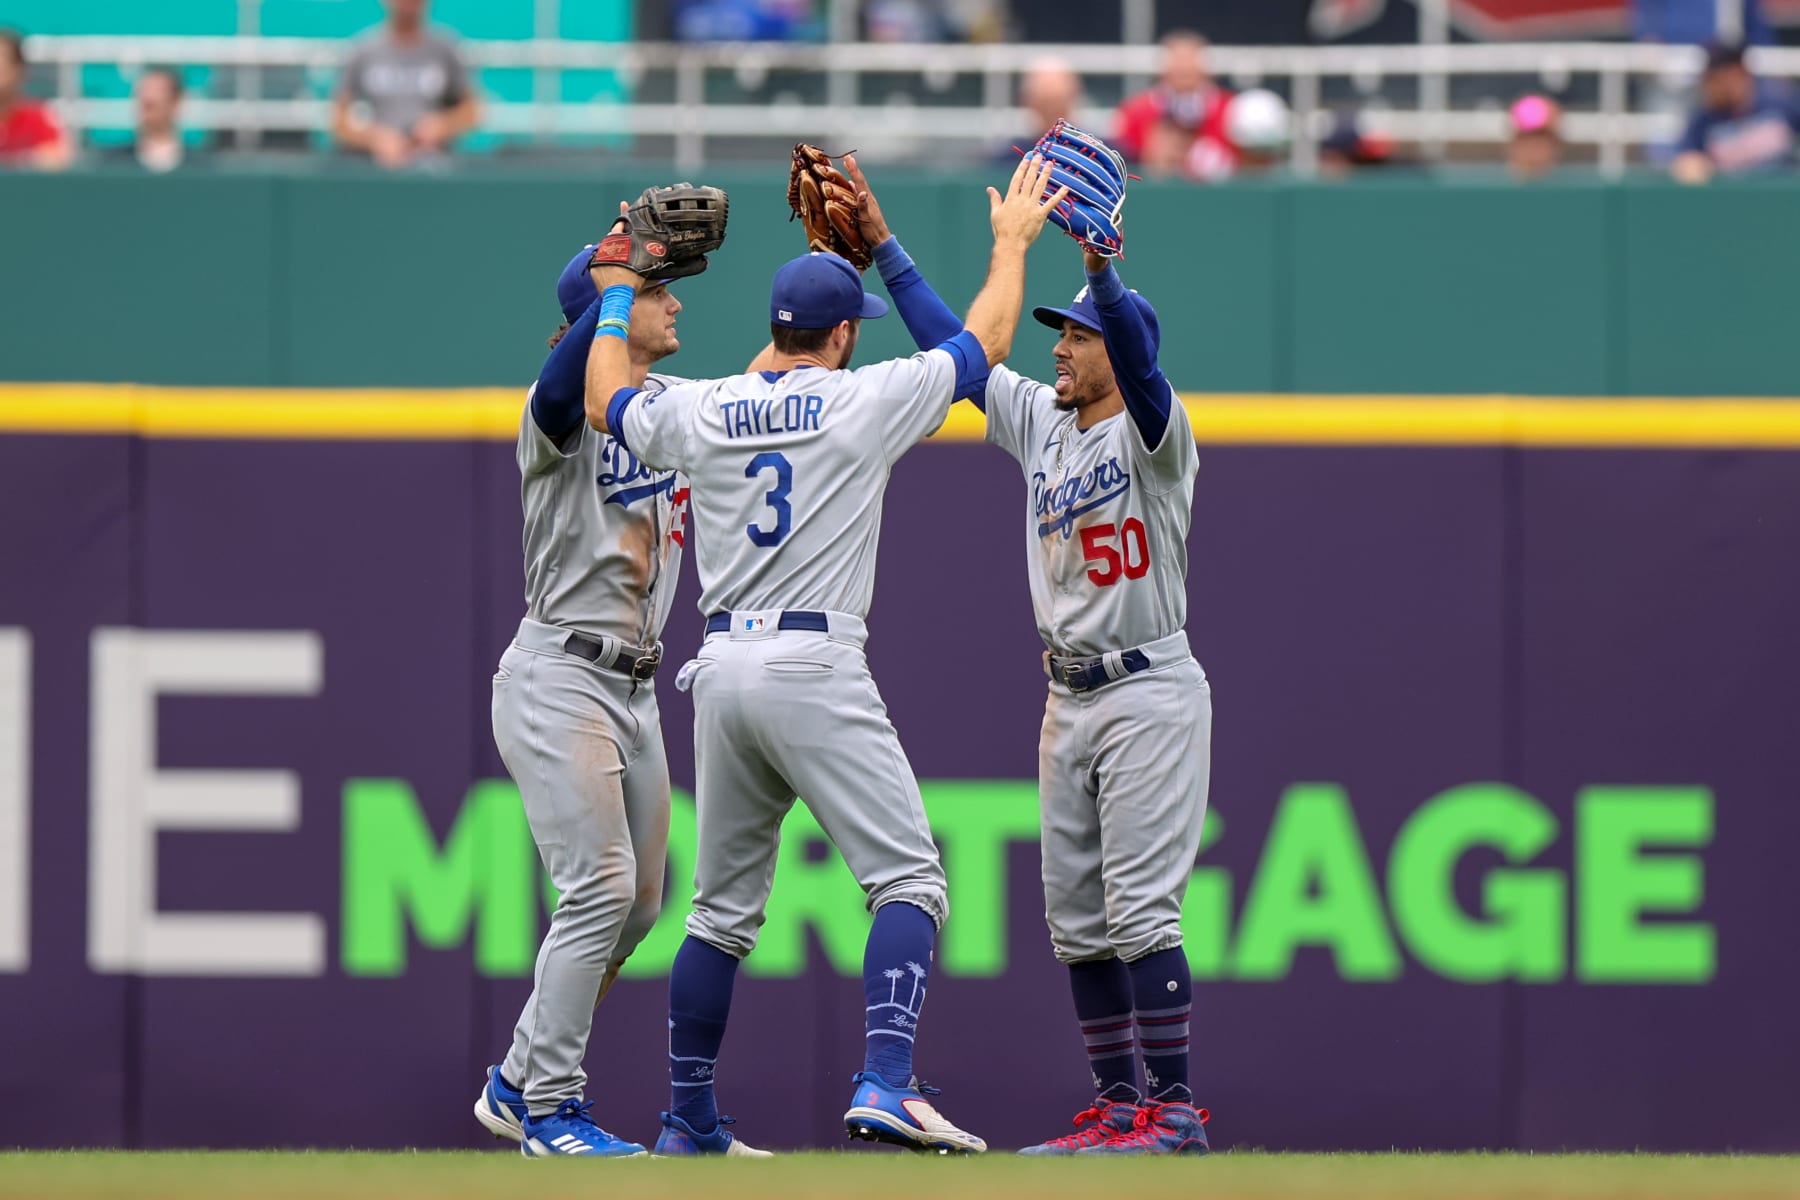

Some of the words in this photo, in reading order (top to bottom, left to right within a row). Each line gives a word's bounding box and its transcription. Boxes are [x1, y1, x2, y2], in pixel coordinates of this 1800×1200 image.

[719, 394, 823, 439] TAYLOR
[744, 452, 793, 548] 3
[1033, 456, 1130, 540] Dodgers
[1079, 516, 1151, 588] 50
[0, 626, 325, 976] E
[343, 780, 1714, 981] MRTAGE
